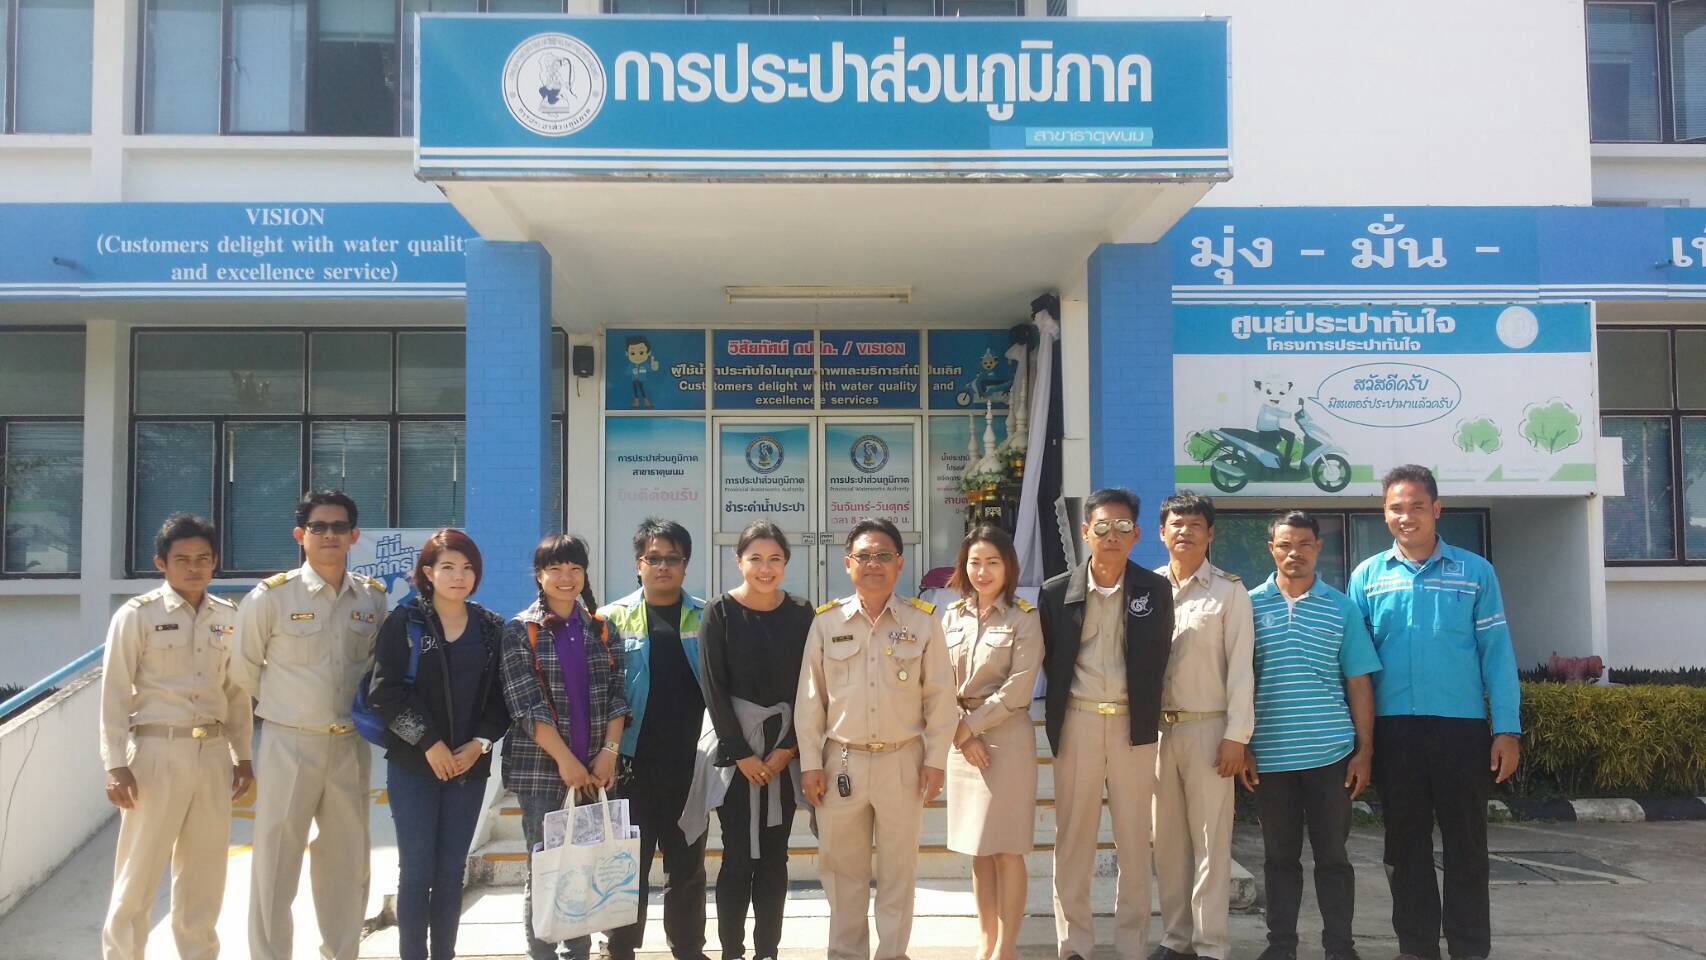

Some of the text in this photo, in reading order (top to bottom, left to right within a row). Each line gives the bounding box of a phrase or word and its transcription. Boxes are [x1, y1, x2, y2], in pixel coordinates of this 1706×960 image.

[614, 36, 1153, 121] การประปาส่วนภูมิภาค
[1034, 130, 1144, 144] สาขาธาตุพนม
[246, 208, 325, 226] VISION
[96, 234, 467, 257] (Customers delight with water qualit
[1190, 225, 1273, 285] มุ่ง
[1351, 213, 1447, 268] มั่น
[171, 262, 398, 282] and excellence service)
[1231, 308, 1456, 340] ศูนย์ประปาทันใจ
[856, 343, 905, 356] VISION
[1266, 336, 1421, 351] โครงการประปาทันใจ
[758, 381, 798, 392] delight
[841, 382, 874, 391] water
[878, 381, 917, 392] quality
[933, 381, 954, 391] and
[1353, 374, 1429, 391] สวัสดีครับ
[831, 395, 879, 405] services
[618, 453, 699, 464] การประปาส่วนภูมิภาค
[632, 468, 685, 477] สาขาธาตุพนม
[725, 475, 805, 486] การประปาส่วนภูมิภาค
[830, 475, 910, 486] การประปาส่วนภูมิภาค
[725, 498, 805, 513] ชำระค่าน้ำประปา
